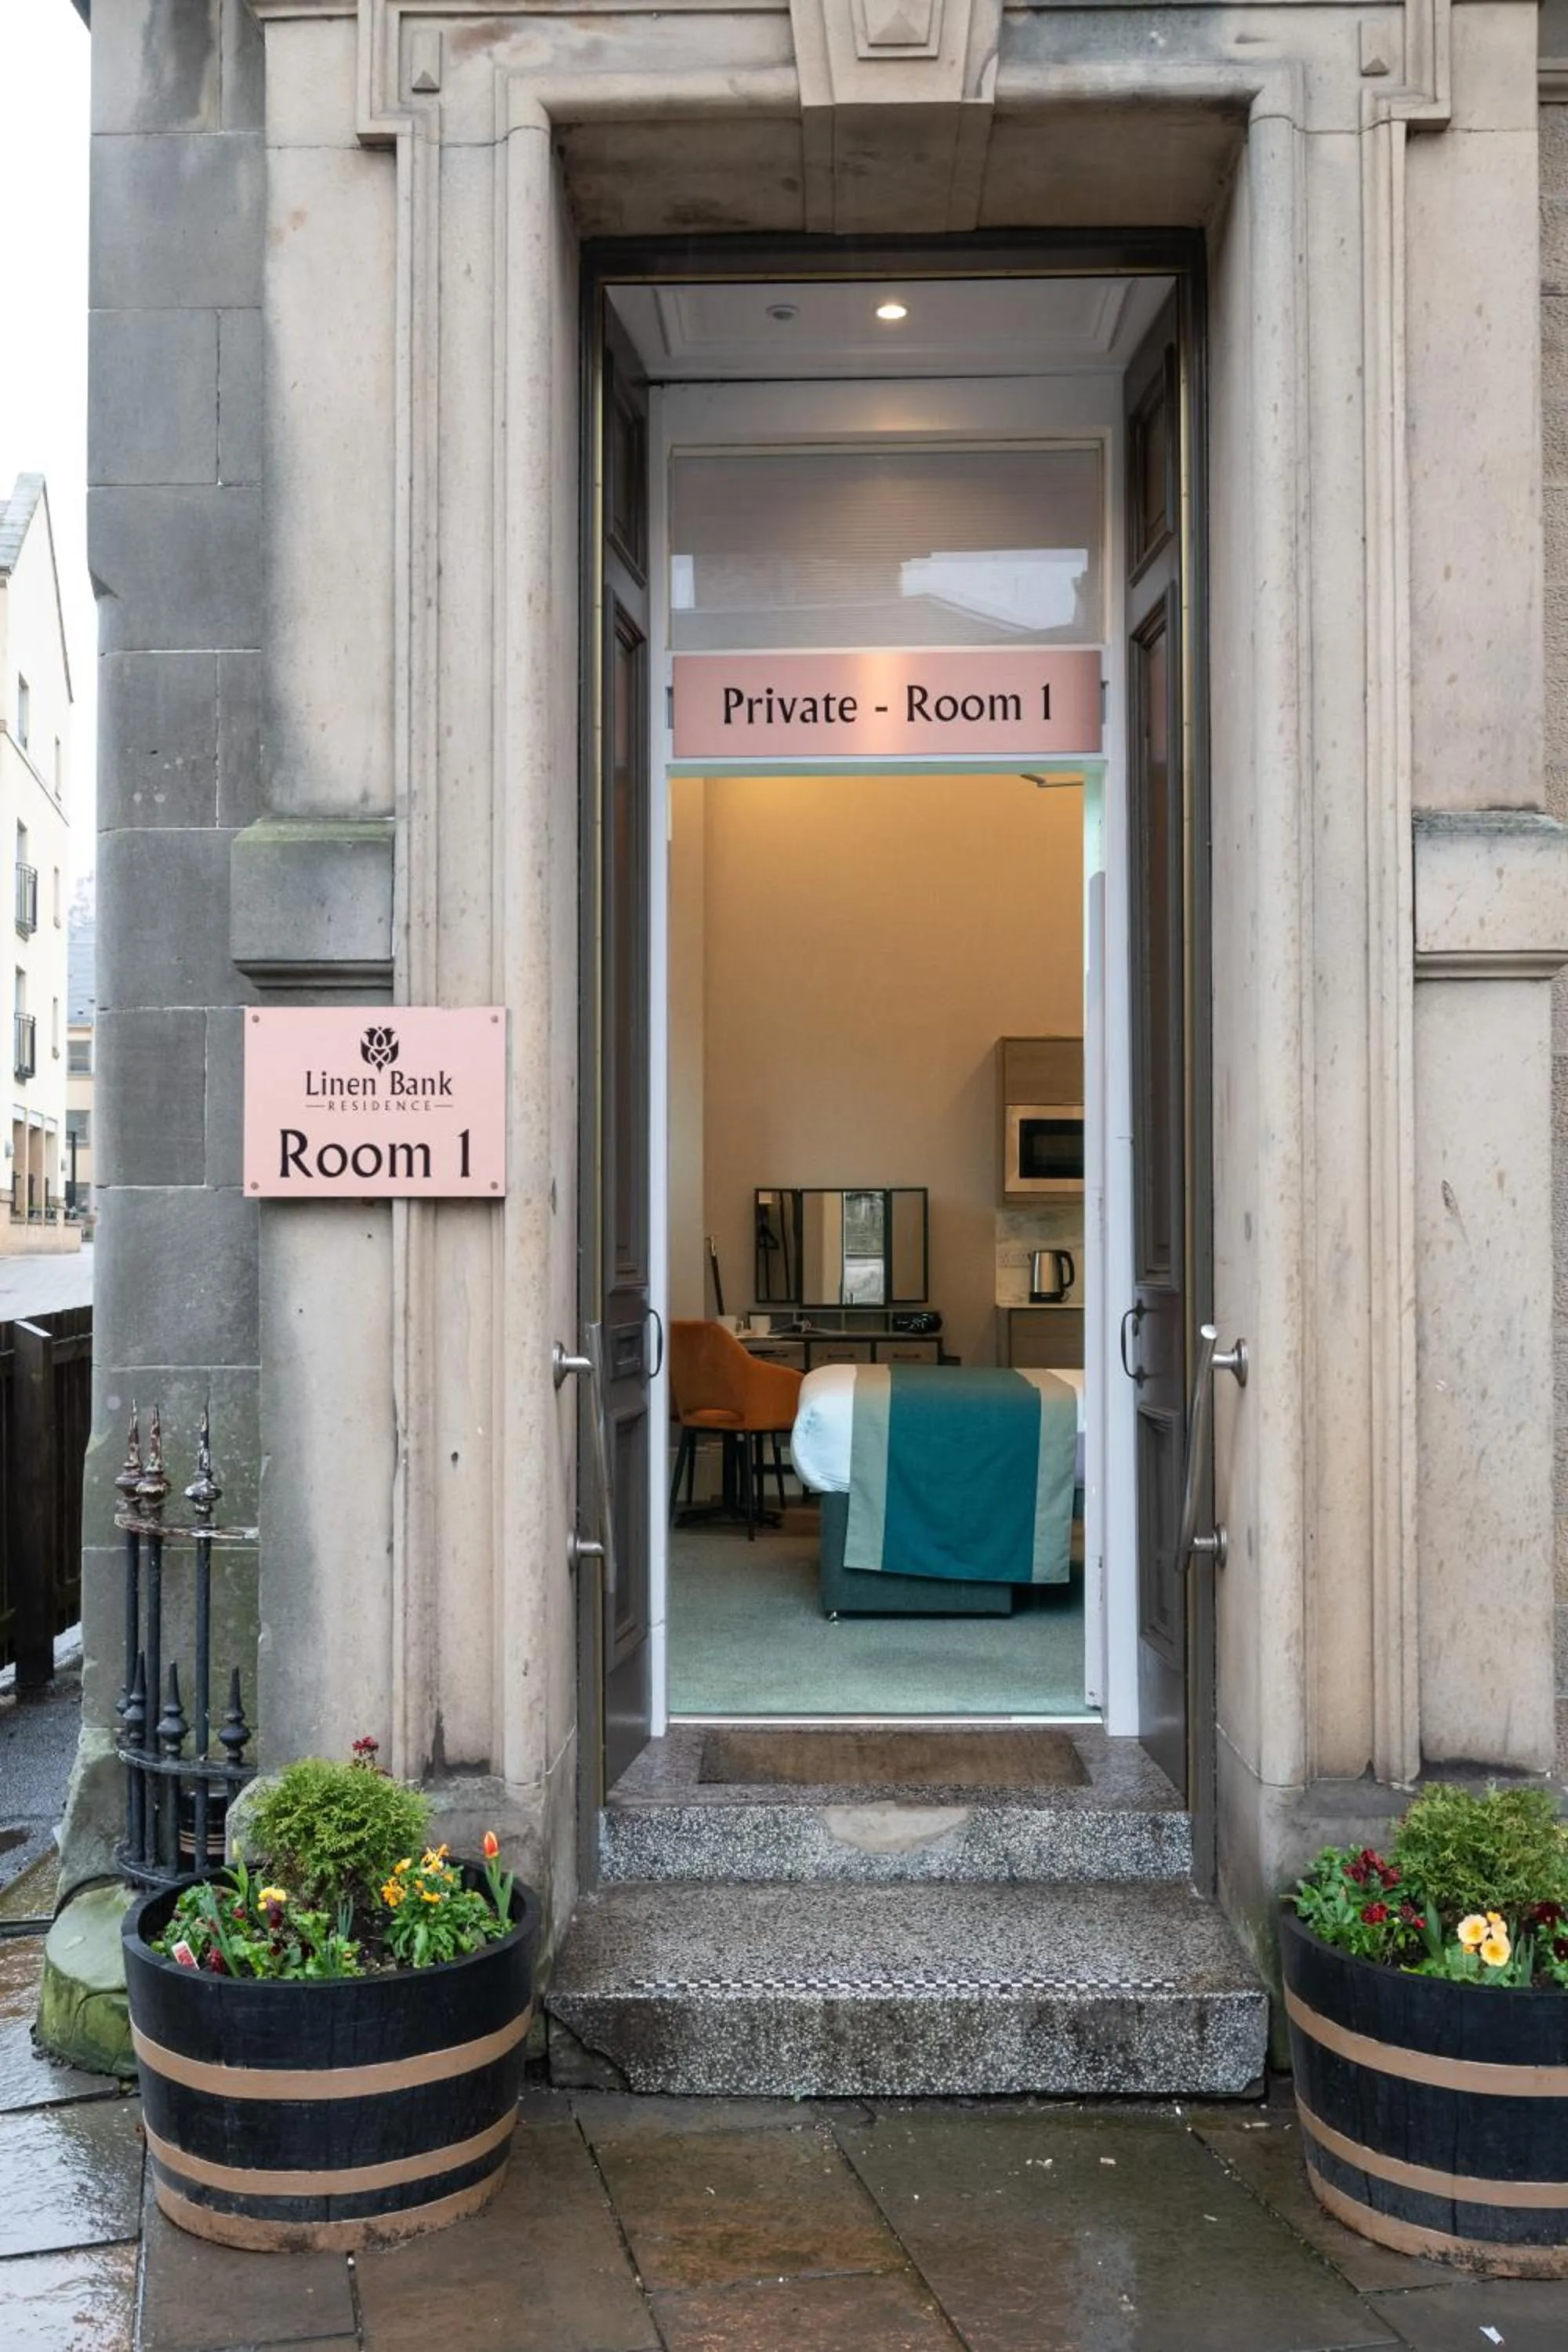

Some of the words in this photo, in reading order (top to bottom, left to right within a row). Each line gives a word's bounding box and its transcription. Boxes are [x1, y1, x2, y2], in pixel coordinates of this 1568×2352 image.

[724, 687, 858, 725] Private
[906, 684, 1022, 722] Room
[1041, 683, 1052, 720] 1
[306, 1070, 376, 1096] Linen
[390, 1070, 452, 1096] Bank
[328, 1100, 431, 1111] RESIDENCE
[279, 1128, 431, 1178] Room
[457, 1128, 471, 1178] 1
